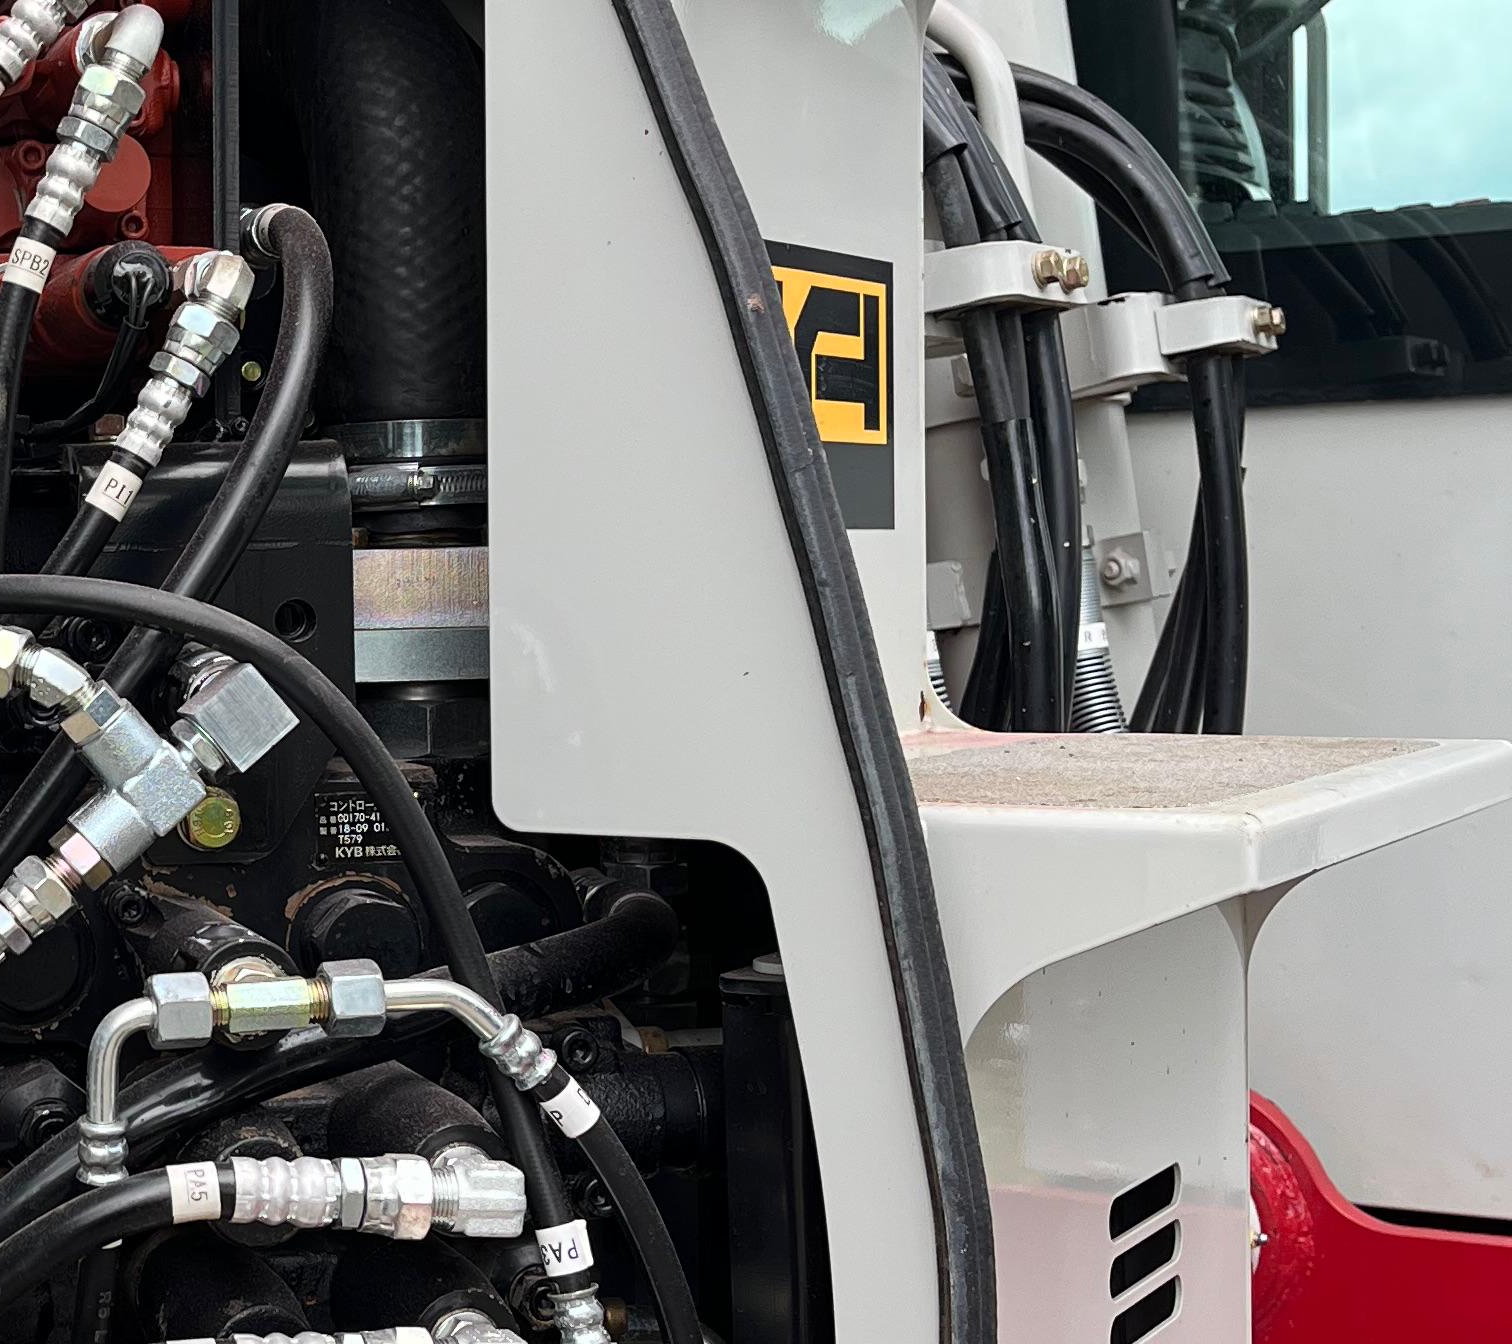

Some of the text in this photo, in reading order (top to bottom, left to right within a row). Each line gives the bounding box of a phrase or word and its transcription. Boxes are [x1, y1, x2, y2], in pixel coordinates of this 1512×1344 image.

[10, 246, 51, 276] SPB2
[329, 799, 377, 812] コントロー
[334, 846, 363, 859] KYB
[187, 1164, 209, 1203] PA5
